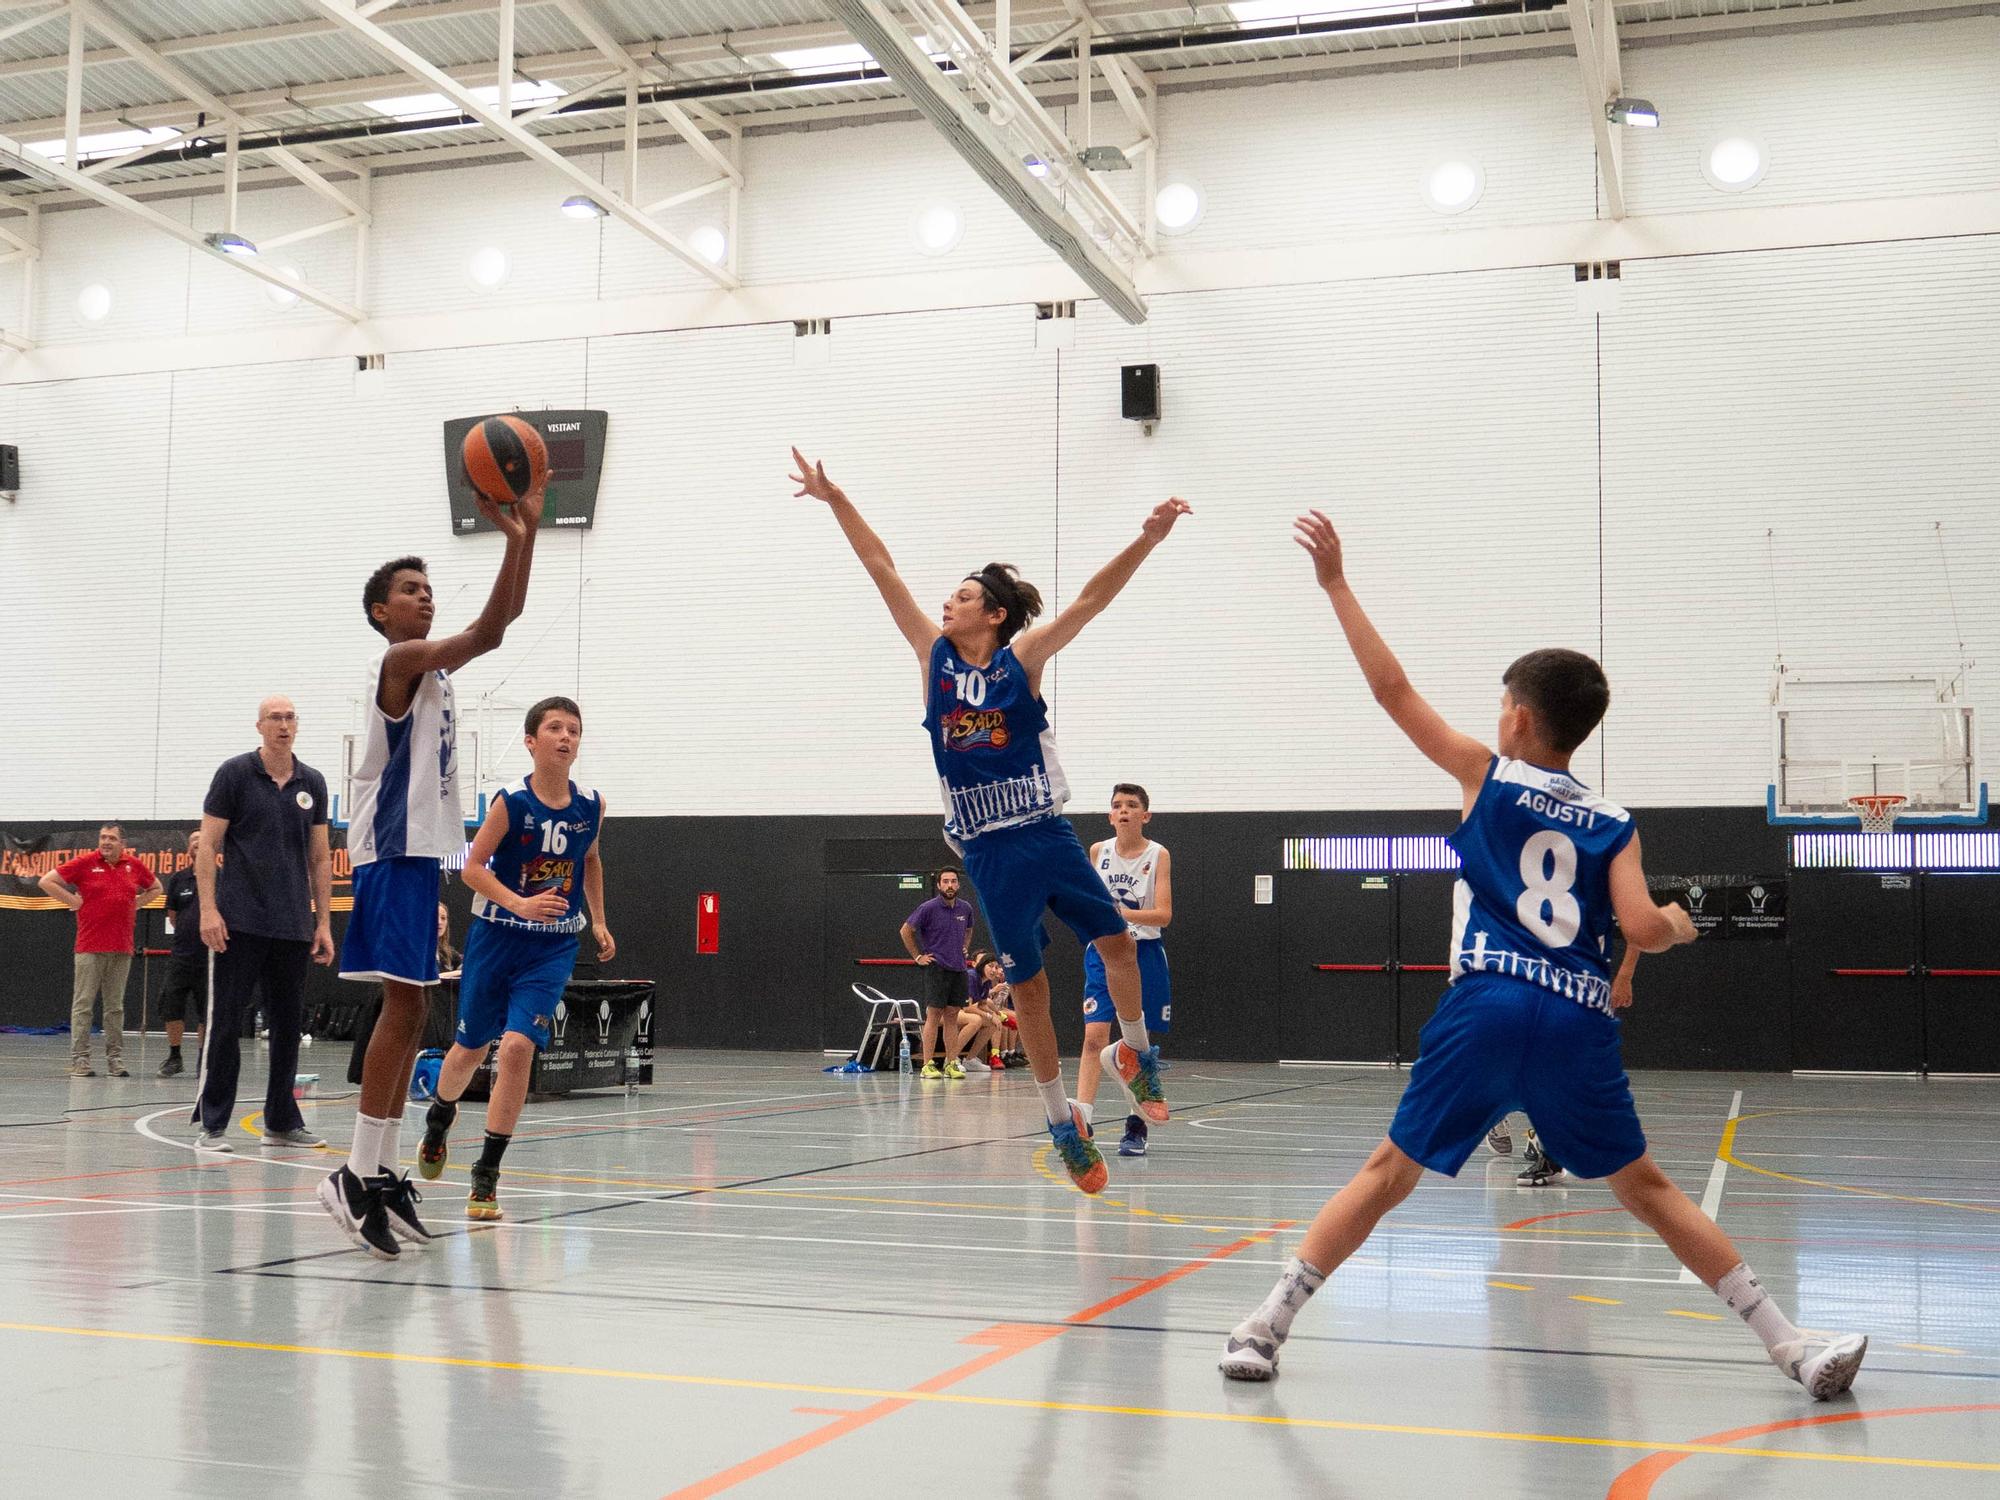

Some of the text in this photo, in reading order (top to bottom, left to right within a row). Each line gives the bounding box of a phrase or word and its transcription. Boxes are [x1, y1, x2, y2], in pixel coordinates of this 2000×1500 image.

[547, 422, 581, 432] VISITANT
[556, 516, 587, 525] MONDO
[955, 670, 986, 706] 10
[541, 819, 568, 855] 16
[1101, 859, 1110, 870] 6
[1108, 873, 1139, 887] ADEPAF
[1517, 829, 1581, 949] 8
